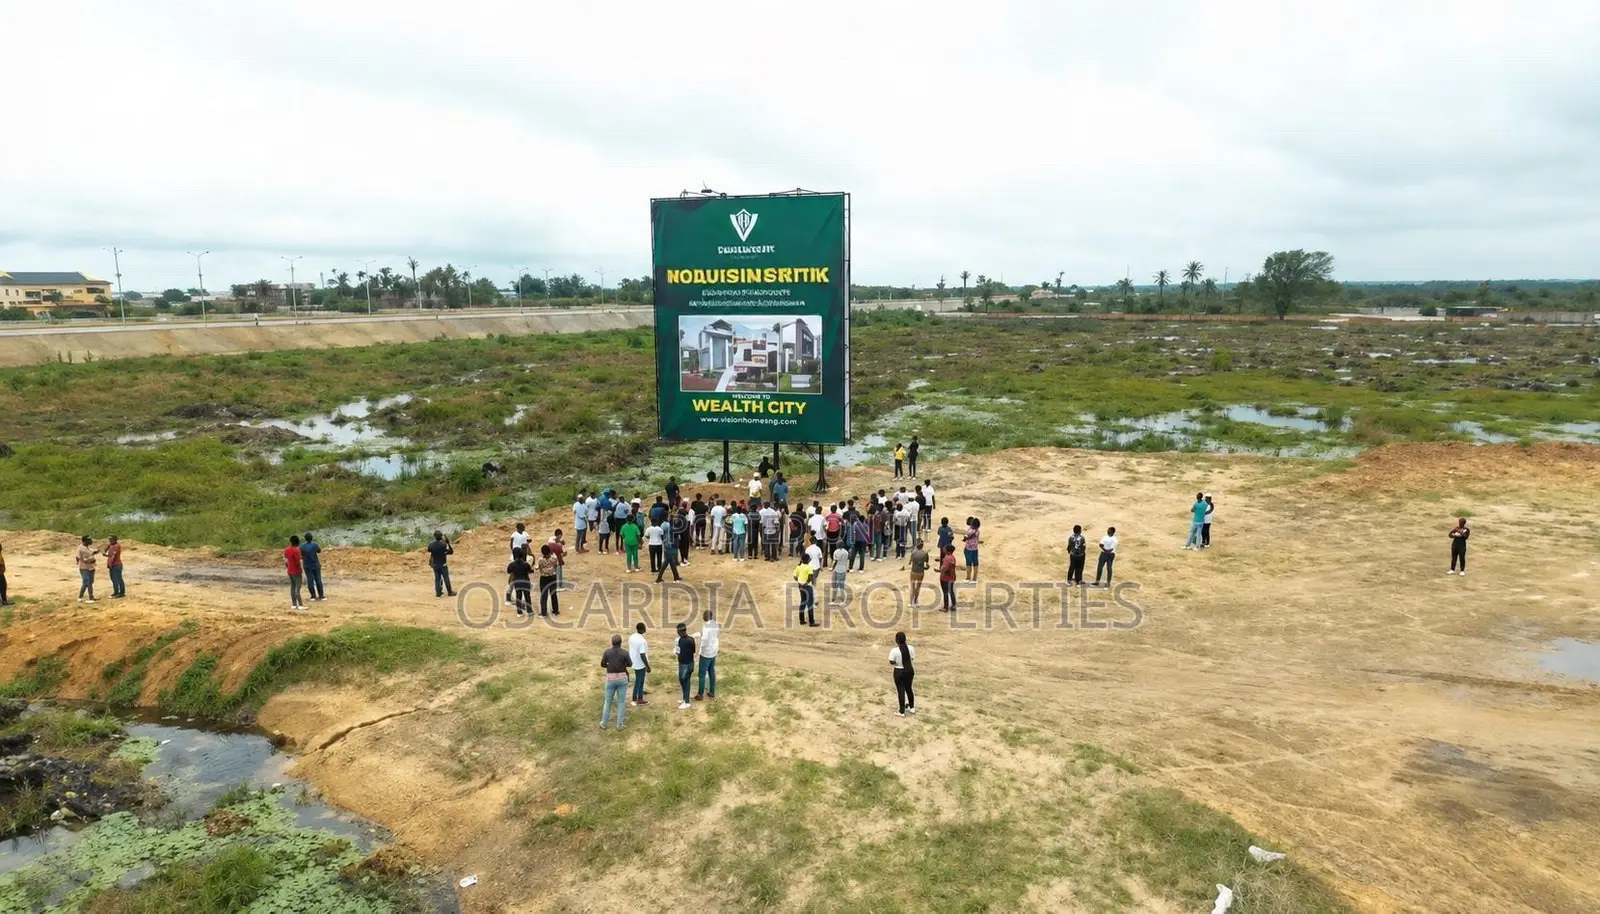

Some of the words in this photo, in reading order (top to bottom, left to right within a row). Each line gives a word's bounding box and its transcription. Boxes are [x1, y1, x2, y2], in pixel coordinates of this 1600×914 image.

[692, 399, 763, 414] WEALTH
[767, 401, 807, 414] CITY
[700, 416, 797, 425] www.visionhomesng.com
